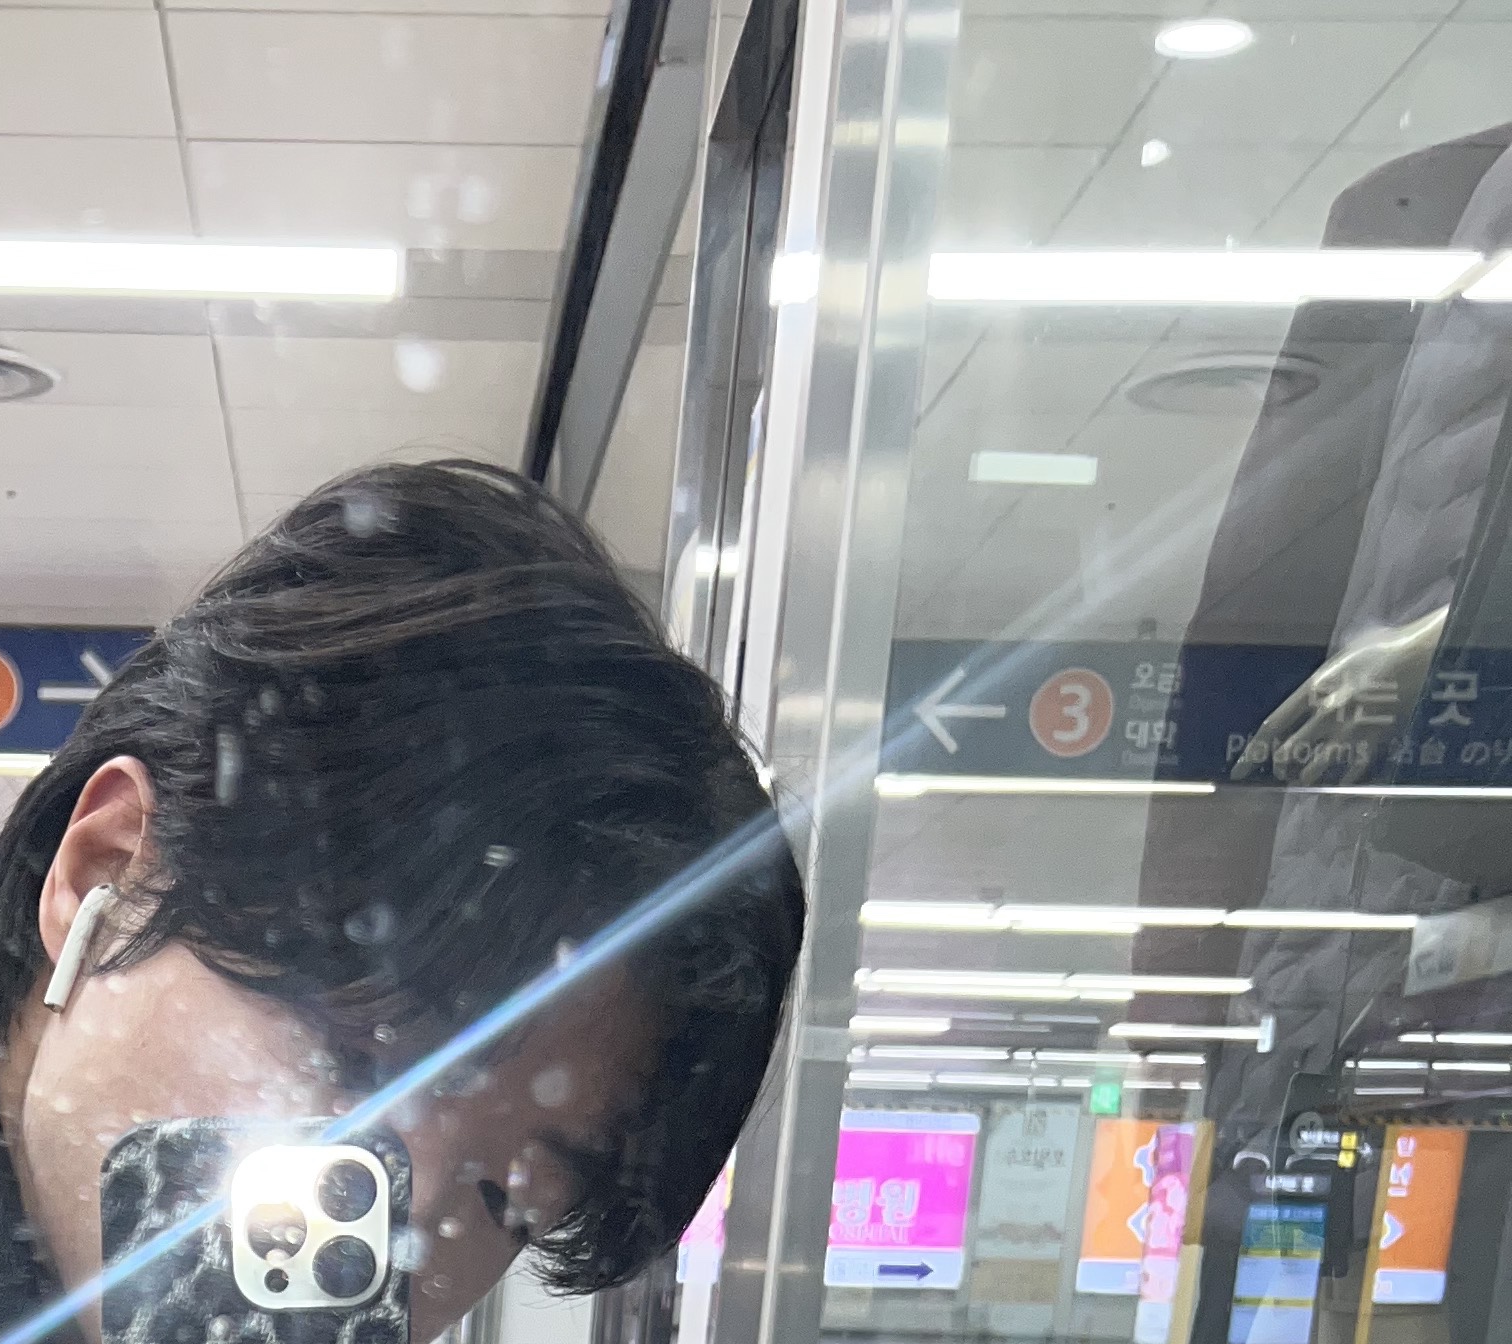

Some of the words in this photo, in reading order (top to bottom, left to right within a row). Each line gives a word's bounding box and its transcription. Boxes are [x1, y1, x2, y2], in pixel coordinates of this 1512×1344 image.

[1128, 662, 1182, 694] 오금
[1428, 671, 1478, 727] 곳
[1056, 686, 1091, 742] 3
[1125, 720, 1179, 749] 대화
